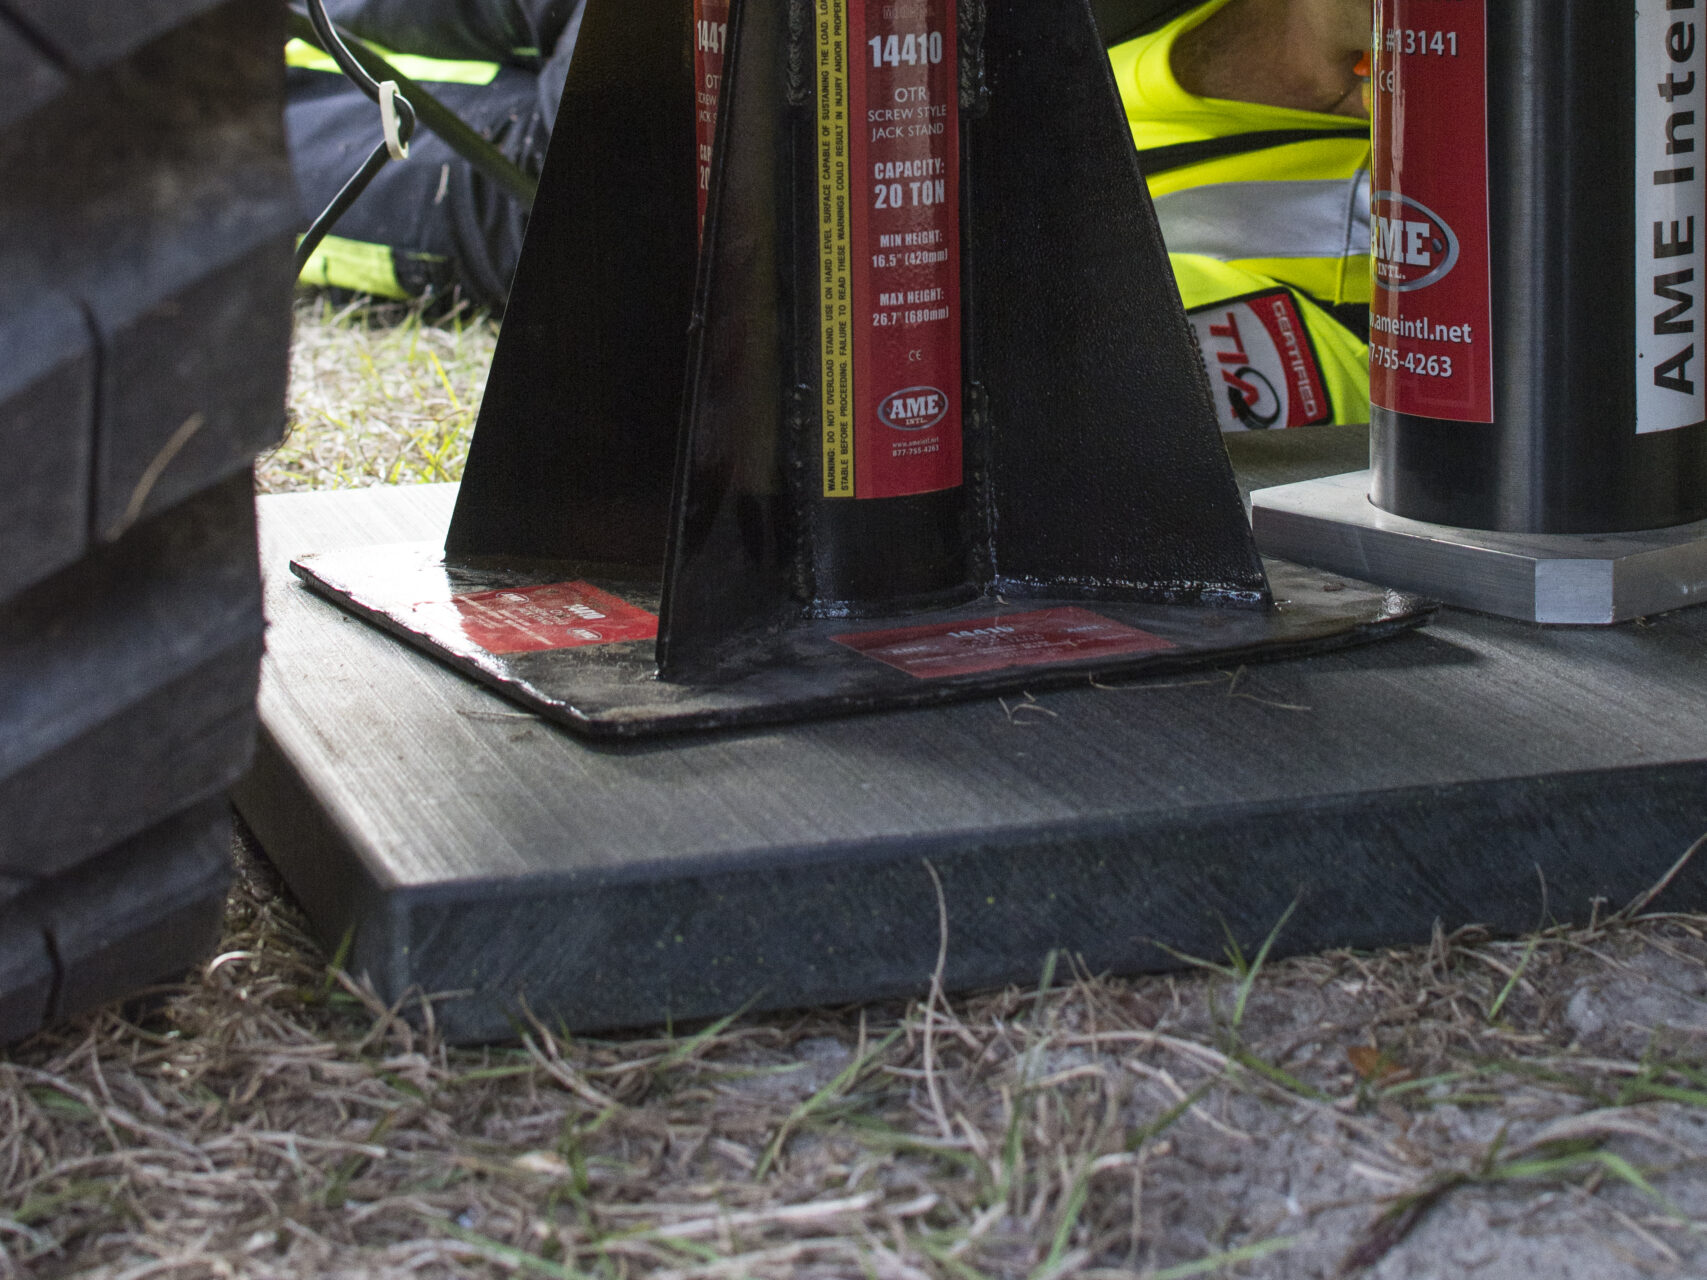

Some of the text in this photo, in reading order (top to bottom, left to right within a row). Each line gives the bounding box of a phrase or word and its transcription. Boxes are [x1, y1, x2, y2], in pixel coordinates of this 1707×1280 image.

[820, 20, 829, 45] LOAD.
[1386, 29, 1459, 56] #13141
[821, 51, 829, 66] THE
[833, 40, 842, 72] AND/OR
[868, 31, 943, 68] 14410
[705, 73, 723, 89] OT
[834, 77, 843, 106] INJURY
[821, 71, 830, 120] SUSTAINING
[894, 87, 928, 104] OTR
[834, 111, 843, 120] IN
[868, 104, 947, 122] SCREW STYLE
[822, 126, 830, 136] OF
[835, 125, 843, 156] RESULT
[872, 122, 945, 143] JACK STAND
[822, 141, 831, 180] CAPABLE
[874, 157, 945, 180] CAPACITY:
[836, 162, 844, 190] COULD
[823, 184, 831, 223] SURFACE
[874, 179, 946, 209] 20 TON
[836, 196, 845, 240] WARNINGS
[824, 229, 832, 254] LEVEL
[880, 229, 943, 248] MIN HEIGHT:
[837, 246, 846, 271] THESE
[904, 248, 949, 267] (420mm)
[824, 259, 832, 282] HARD
[825, 288, 833, 299] ON
[838, 277, 846, 300] READ
[879, 288, 945, 307] MAX HEIGHT:
[825, 304, 833, 320] USE
[838, 305, 846, 316] TO
[904, 305, 950, 324] (680mm)
[1653, 215, 1694, 395] AME
[825, 325, 834, 355] STAND.
[838, 321, 847, 355] FAILURE
[1272, 301, 1318, 417] CERTIFIED
[826, 360, 834, 404] OVERLOAD
[839, 362, 848, 417] PROCEEDING.
[826, 410, 834, 426] NOT
[889, 394, 940, 420] AME
[826, 431, 835, 443] DO
[839, 422, 848, 454] BEFORE
[827, 448, 835, 491] WARNING:
[839, 460, 848, 491] STABLE
